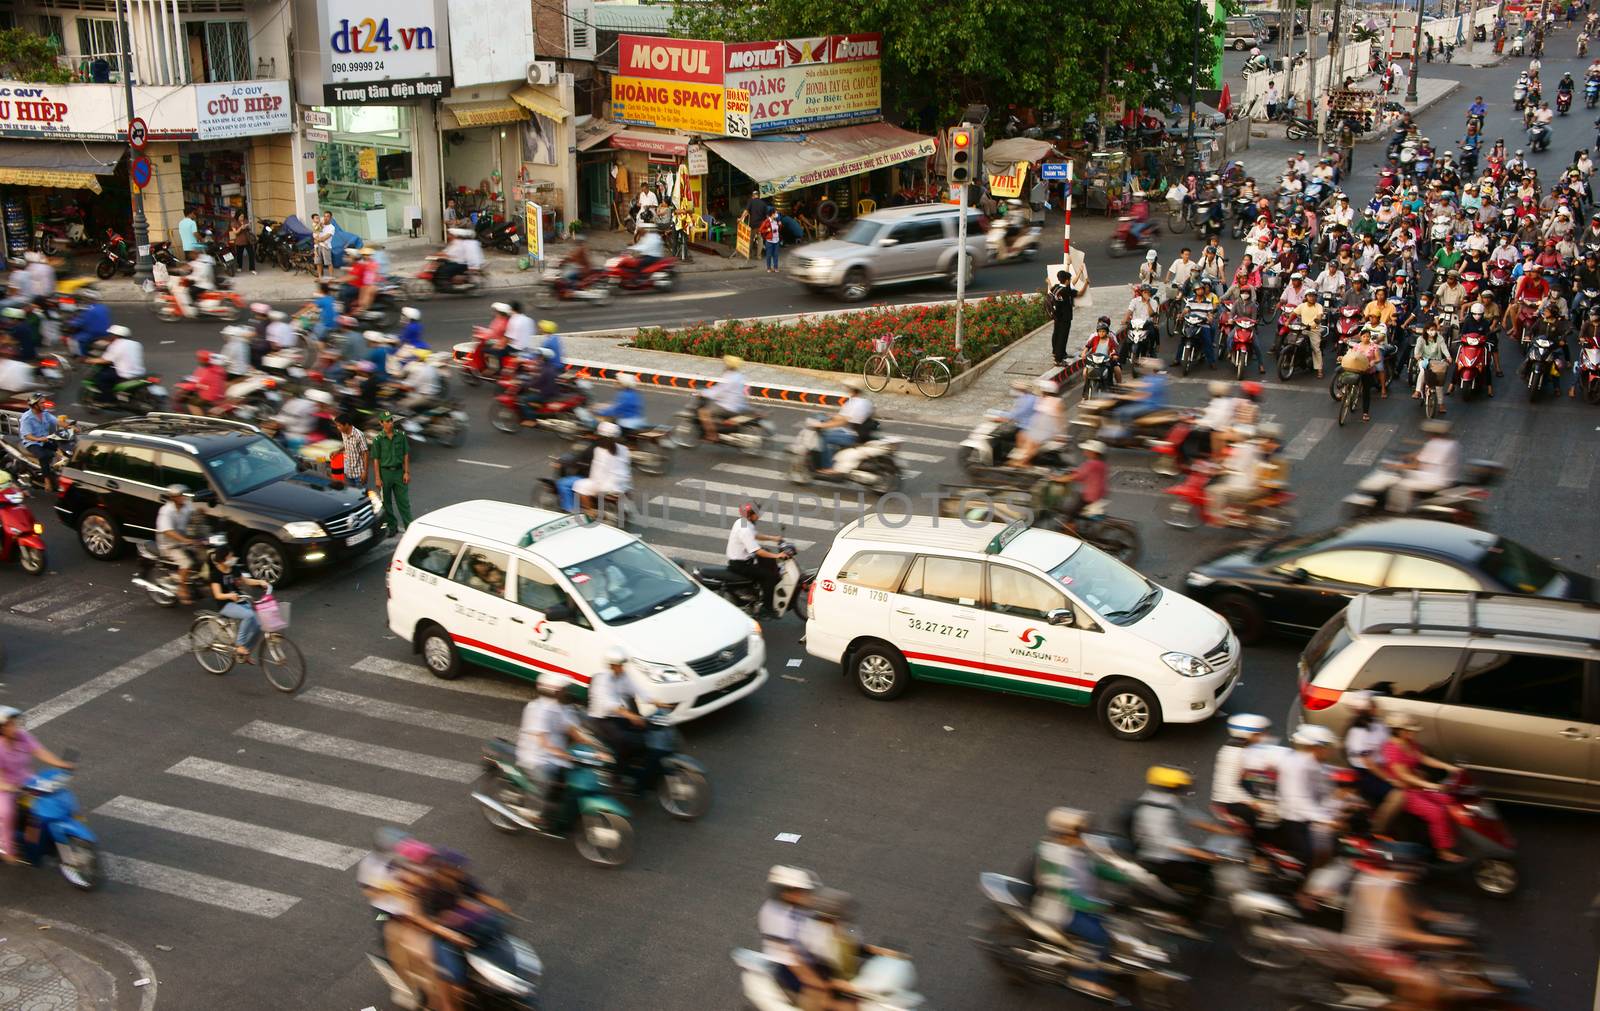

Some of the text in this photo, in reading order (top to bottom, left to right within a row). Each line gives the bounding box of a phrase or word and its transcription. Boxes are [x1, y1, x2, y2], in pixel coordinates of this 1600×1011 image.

[330, 17, 435, 54] dt24.vn
[729, 49, 778, 69] MOTUL
[835, 40, 879, 59] MOTUL
[331, 61, 385, 73] 090.99999 24
[630, 44, 711, 75] MOTUL
[13, 88, 43, 98] QUY
[244, 86, 263, 95] QUY
[334, 80, 443, 102] Trung tâm điện thoại
[615, 82, 722, 110] HOÀNG SPACY
[805, 81, 828, 96] HONDA
[15, 97, 68, 127] HIỆP
[207, 93, 283, 116] CỬU HIỆP
[727, 101, 749, 113] SPACY
[842, 584, 889, 603] 56M 1790
[908, 618, 969, 639] 38.27 27 27
[1009, 648, 1052, 661] VINASUN
